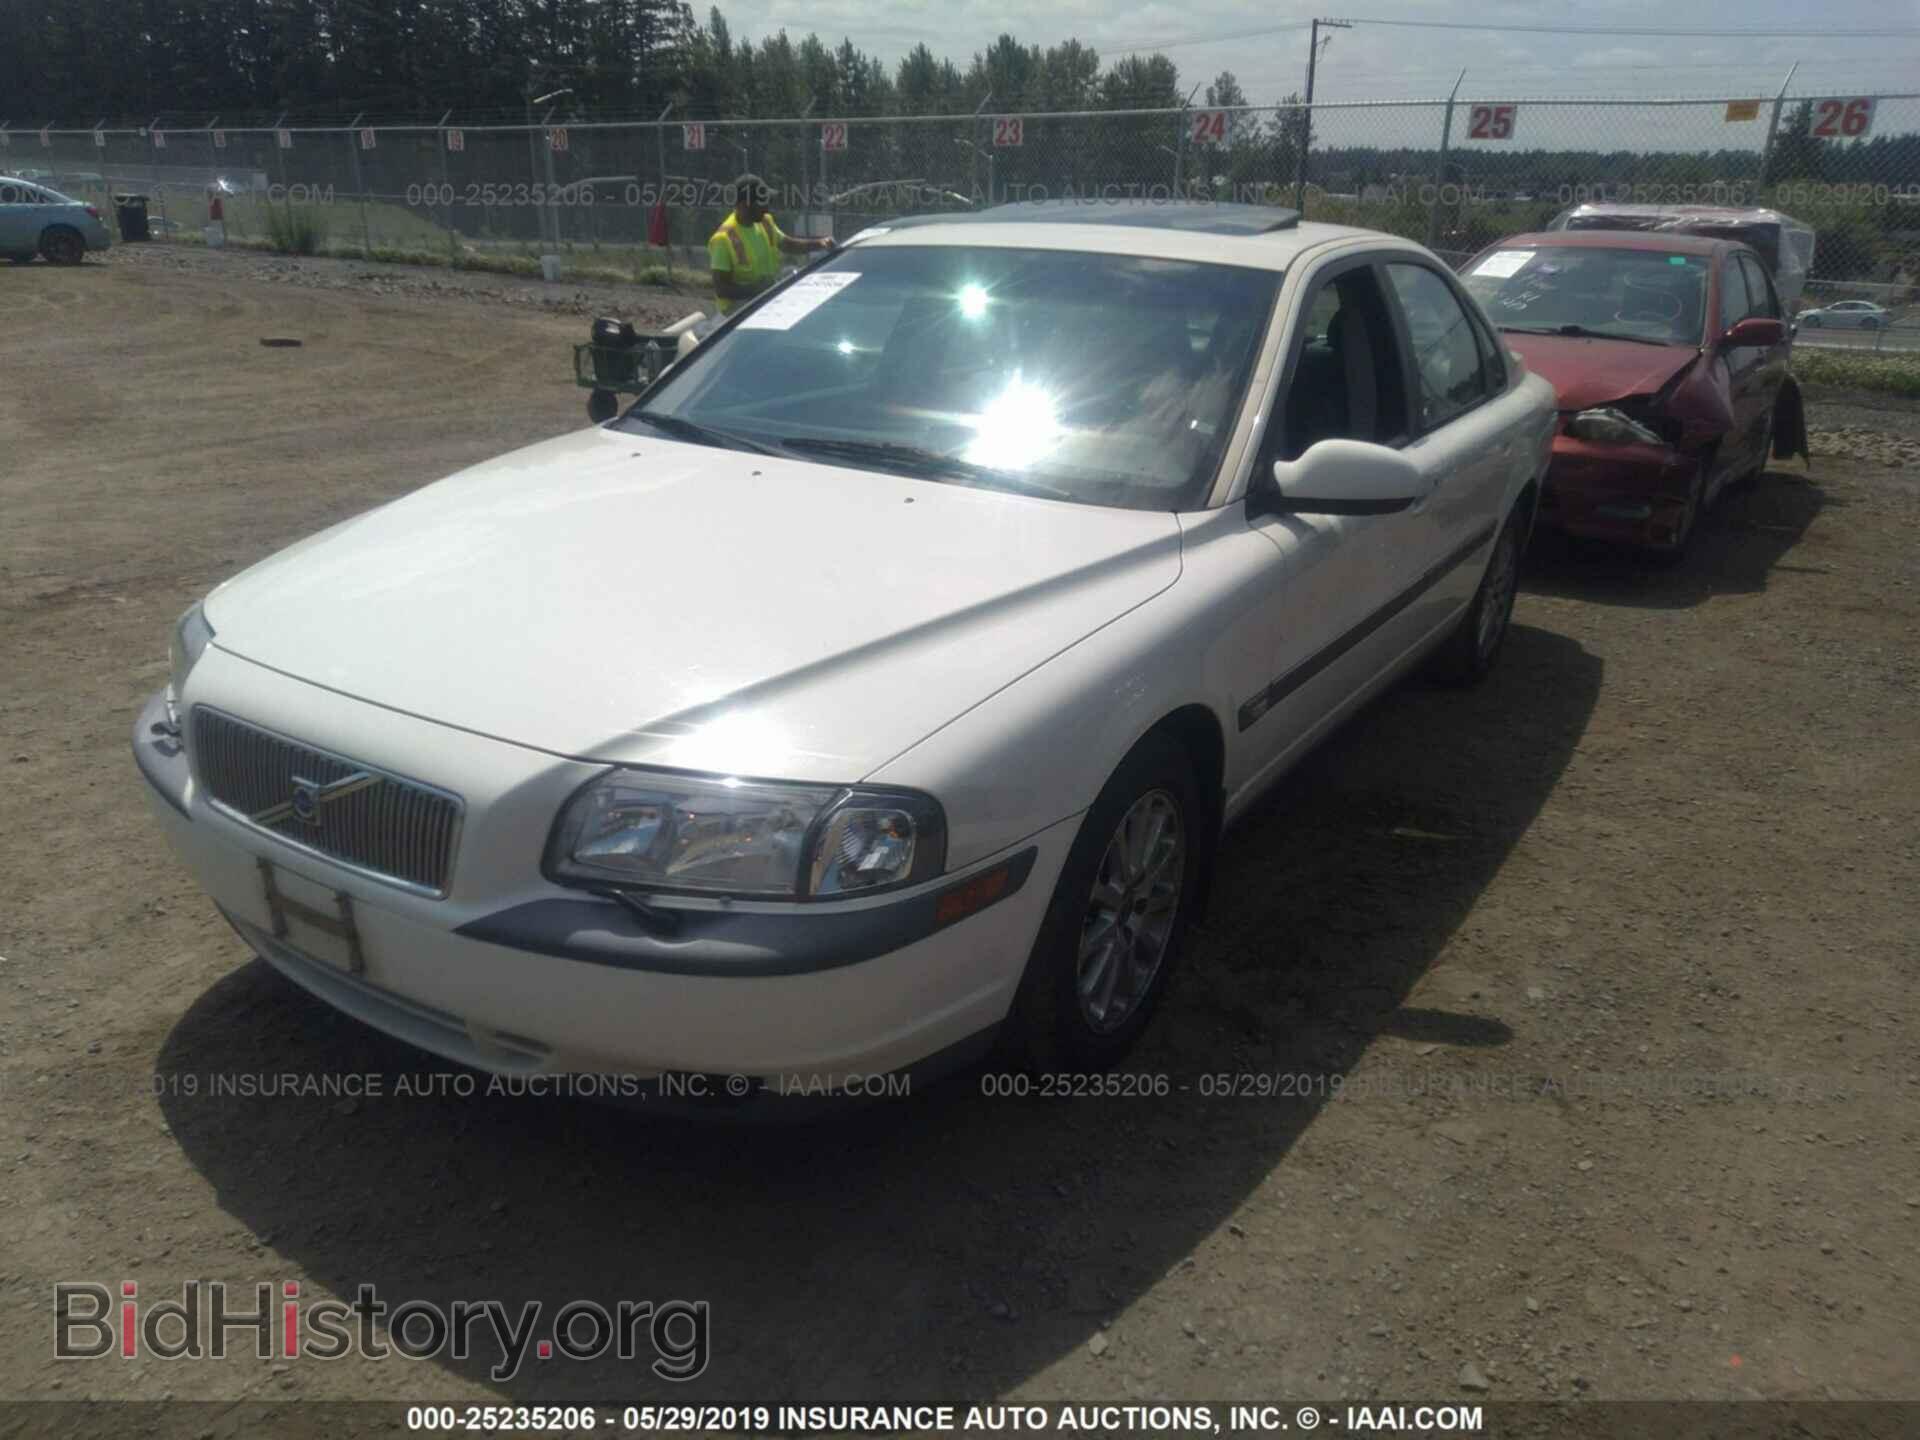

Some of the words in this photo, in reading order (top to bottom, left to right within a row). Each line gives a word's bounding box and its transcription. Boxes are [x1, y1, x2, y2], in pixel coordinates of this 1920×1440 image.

[996, 119, 1023, 145] 23
[1193, 112, 1226, 142] 24
[1470, 106, 1513, 139] 25
[1813, 101, 1870, 138] 26
[551, 128, 568, 149] 20
[687, 124, 703, 149] 21
[823, 123, 848, 150] 22
